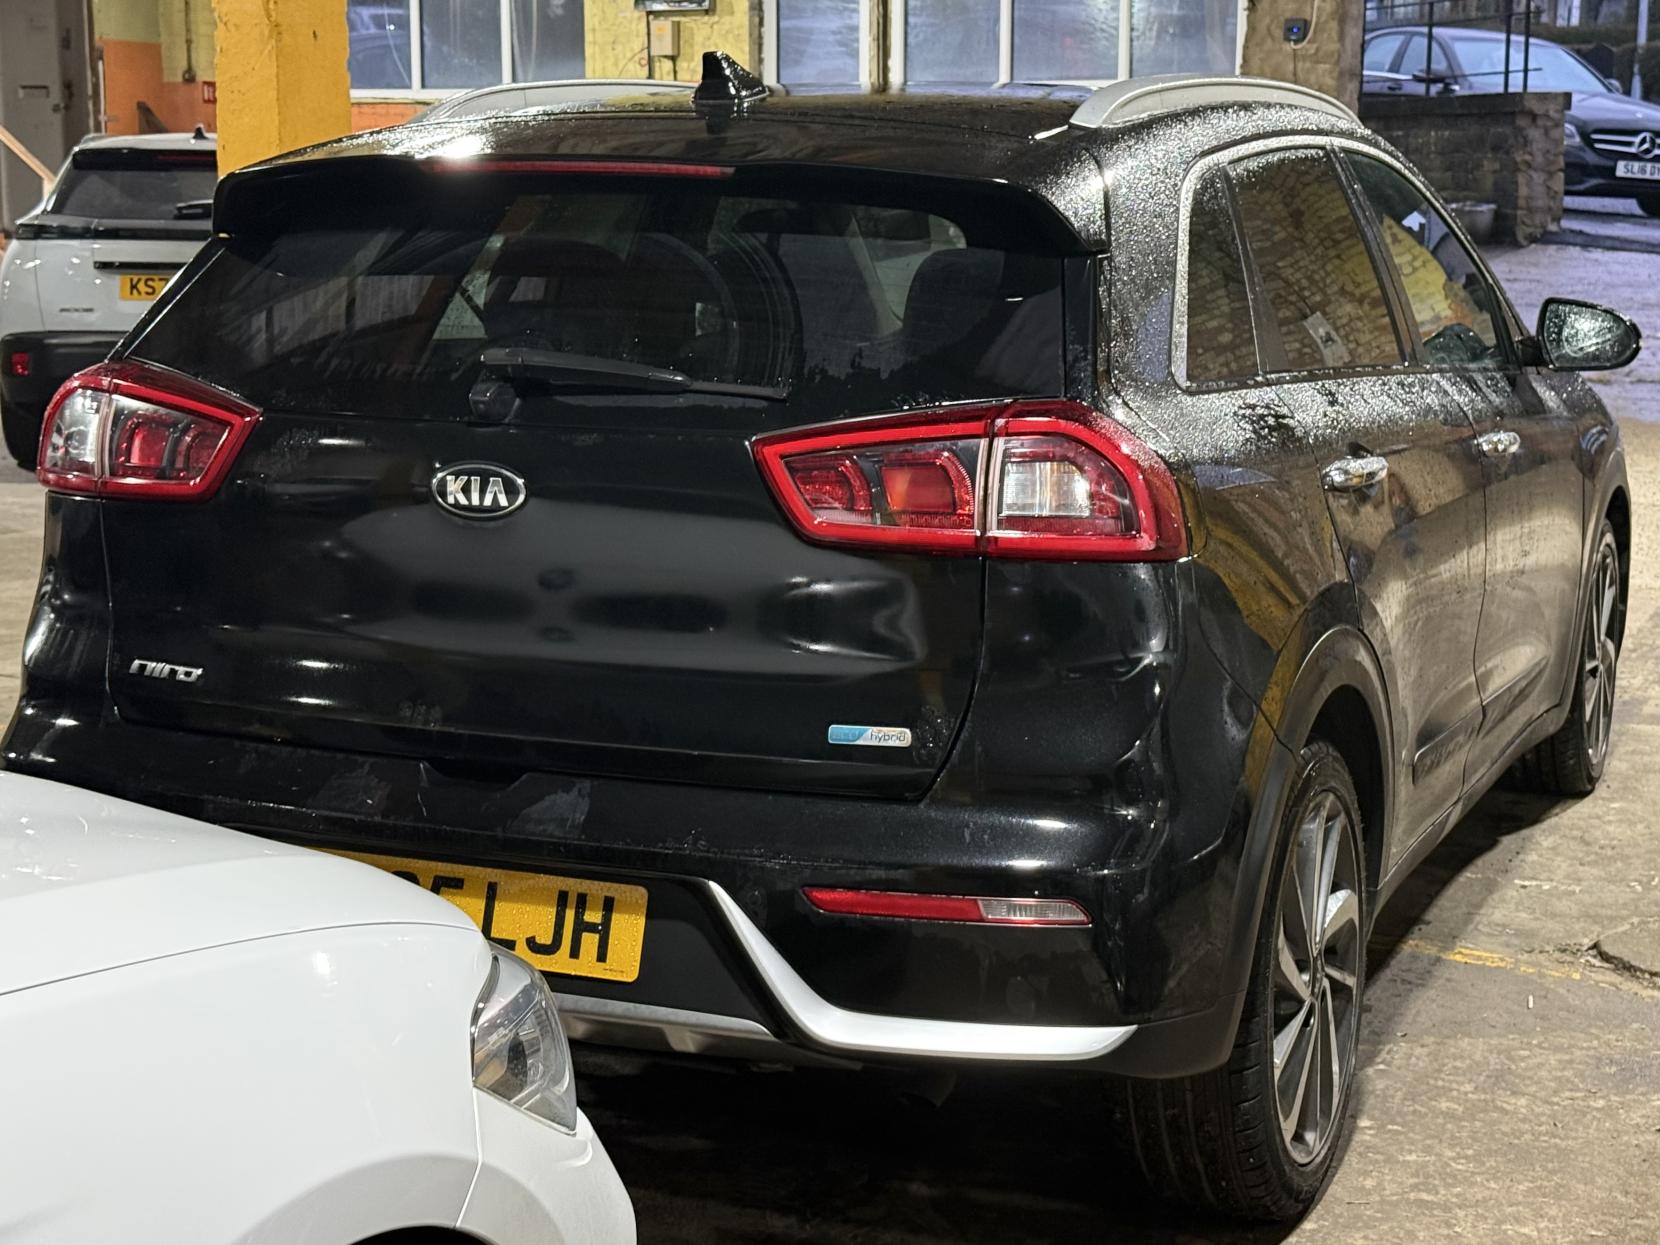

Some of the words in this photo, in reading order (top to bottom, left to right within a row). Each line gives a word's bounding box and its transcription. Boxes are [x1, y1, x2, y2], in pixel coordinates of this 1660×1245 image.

[1623, 163, 1647, 176] SL16
[446, 475, 509, 507] KIA
[129, 659, 204, 682] niro
[870, 731, 906, 744] hybrid
[481, 881, 615, 963] LJH
